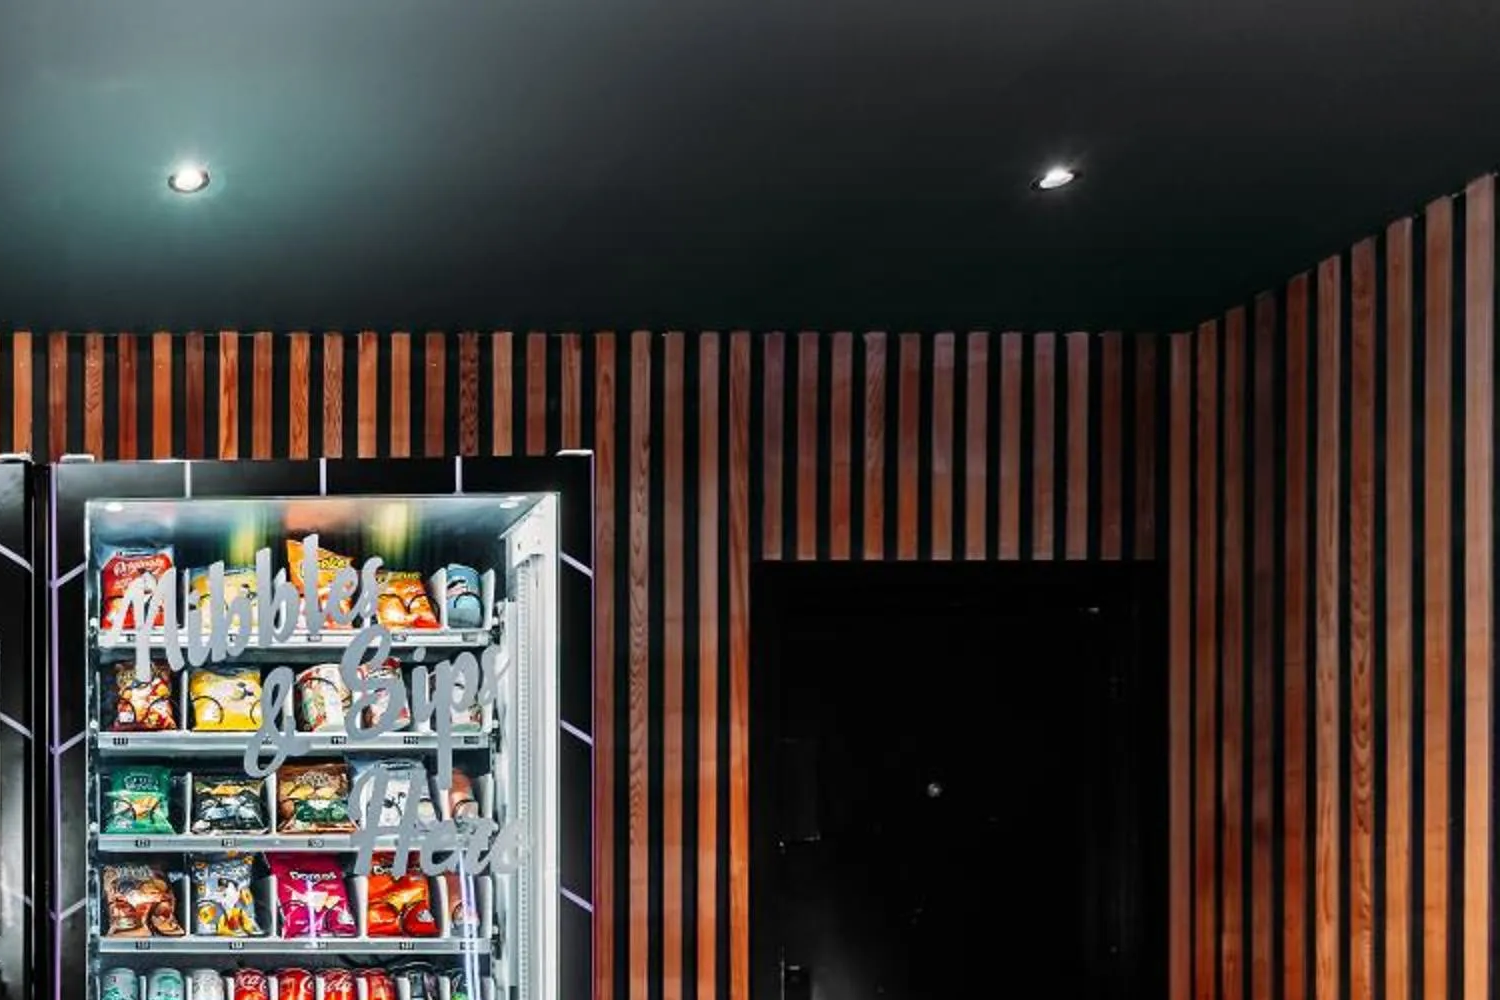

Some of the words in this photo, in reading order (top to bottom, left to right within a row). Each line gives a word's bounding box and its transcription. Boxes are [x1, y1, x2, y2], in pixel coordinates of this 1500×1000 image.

[107, 534, 385, 682] Nibbles
[338, 626, 514, 790] Sips
[349, 766, 533, 876] Here
